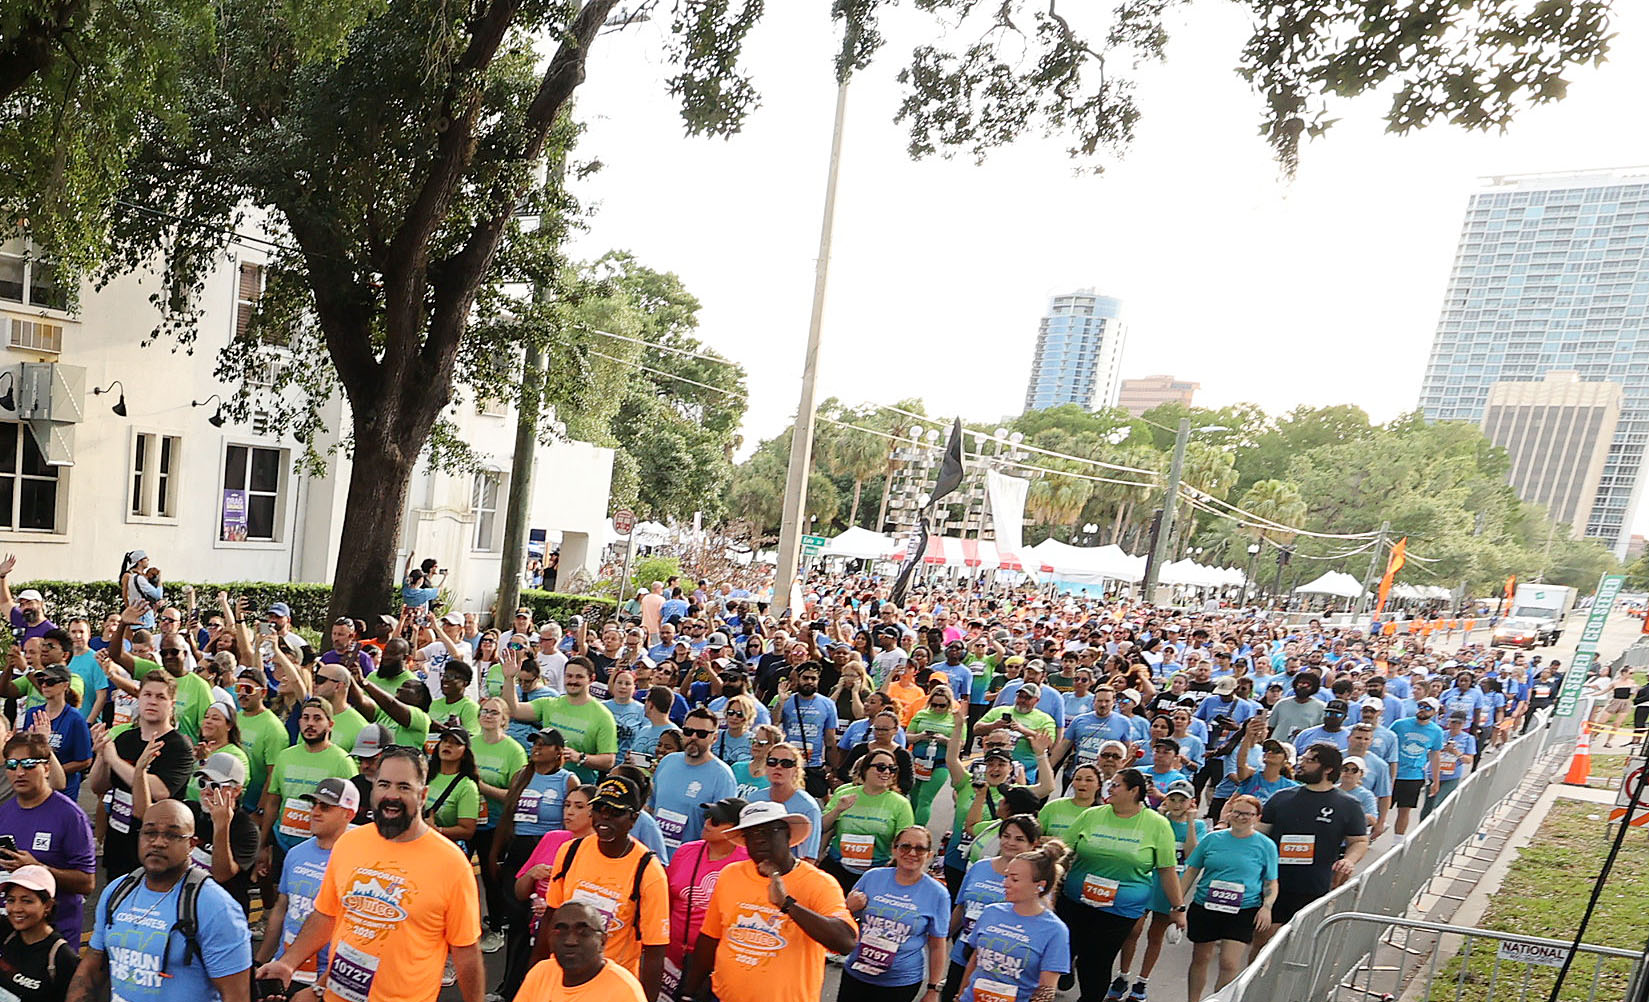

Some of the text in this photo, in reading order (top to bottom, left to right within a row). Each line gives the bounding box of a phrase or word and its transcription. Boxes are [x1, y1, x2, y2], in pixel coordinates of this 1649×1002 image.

[1572, 654, 1592, 691] SEEDED
[35, 838, 48, 847] 5K
[865, 914, 912, 936] WE RUN
[111, 945, 160, 971] WE RUN
[861, 946, 890, 962] 9797
[977, 946, 1023, 969] WE RUN
[1503, 942, 1565, 960] NATIONAL
[132, 968, 163, 988] CITY
[333, 957, 373, 984] 10727
[998, 963, 1024, 979] CITY
[12, 972, 42, 990] CARES
